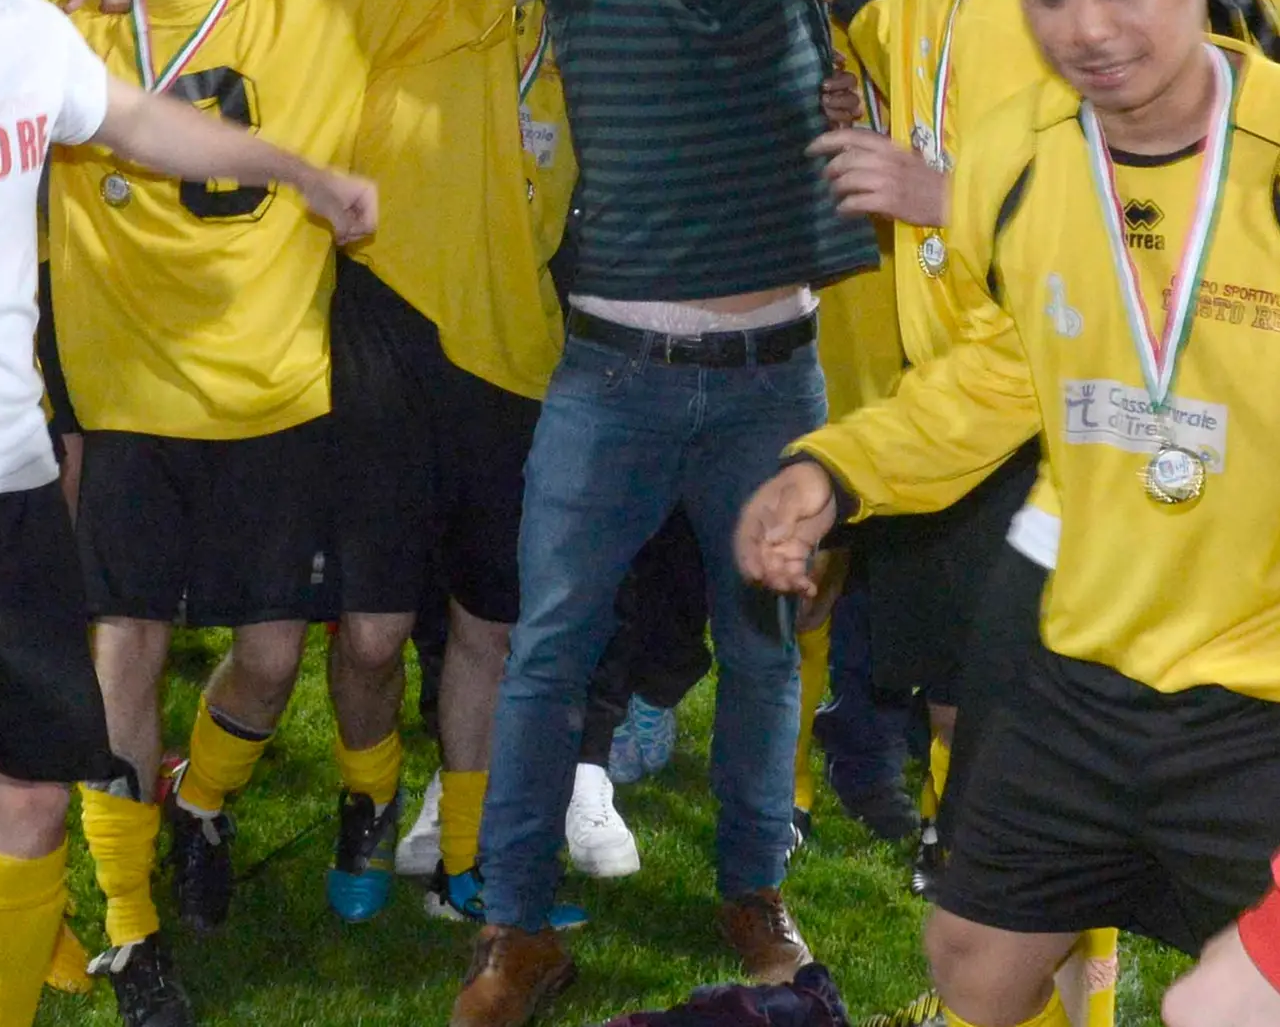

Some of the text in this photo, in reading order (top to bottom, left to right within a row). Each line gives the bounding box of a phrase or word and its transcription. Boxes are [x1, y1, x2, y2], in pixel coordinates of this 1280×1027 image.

[1161, 287, 1246, 324] CSTO
[1125, 414, 1160, 436] Tre
[1170, 408, 1218, 431] urale
